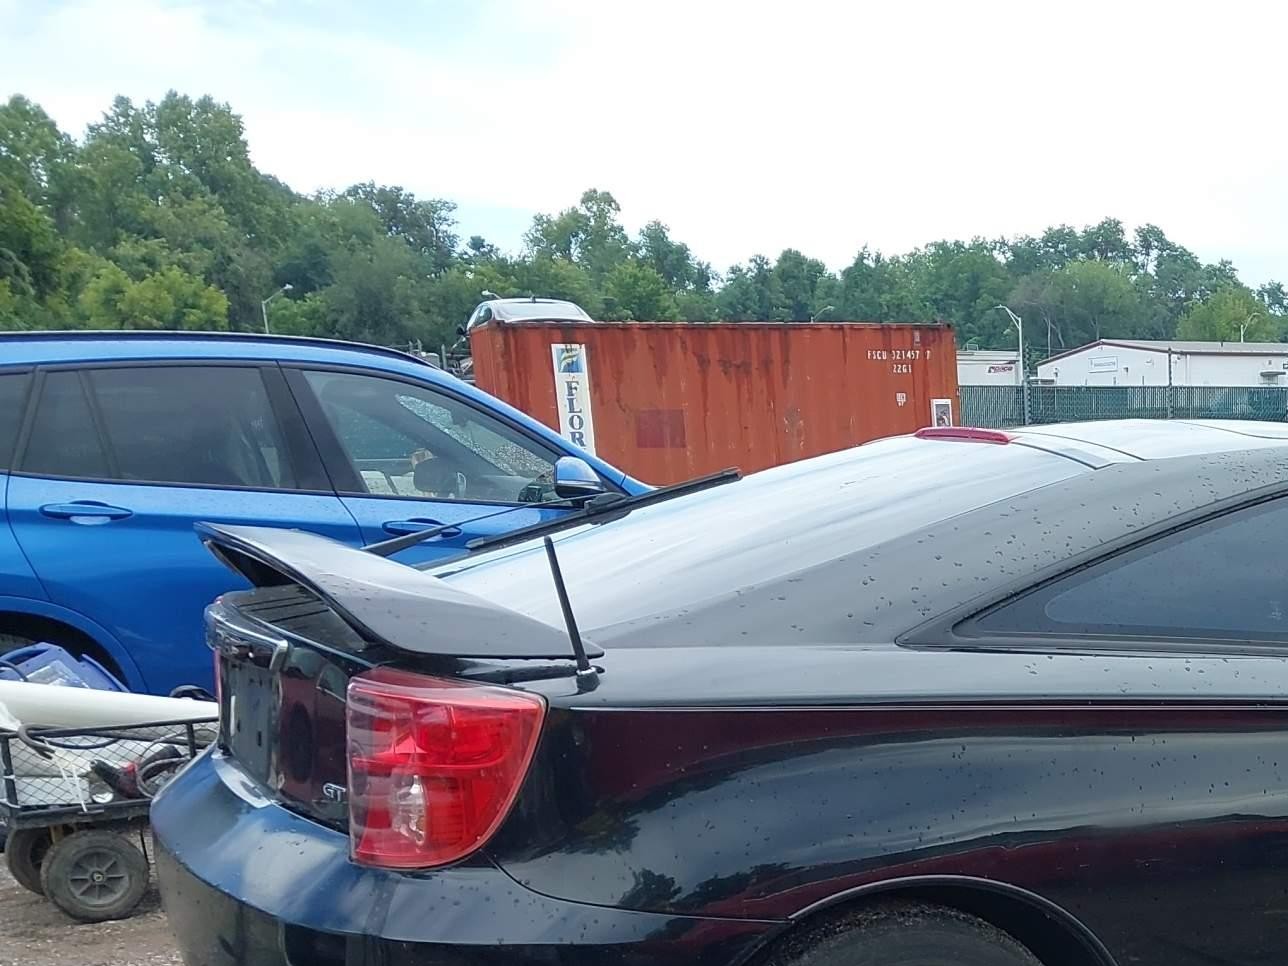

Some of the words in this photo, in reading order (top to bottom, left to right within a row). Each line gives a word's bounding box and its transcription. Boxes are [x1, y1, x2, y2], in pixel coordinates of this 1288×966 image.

[867, 350, 887, 360] FSCU
[565, 381, 586, 448] FLOR
[323, 782, 346, 801] GT
